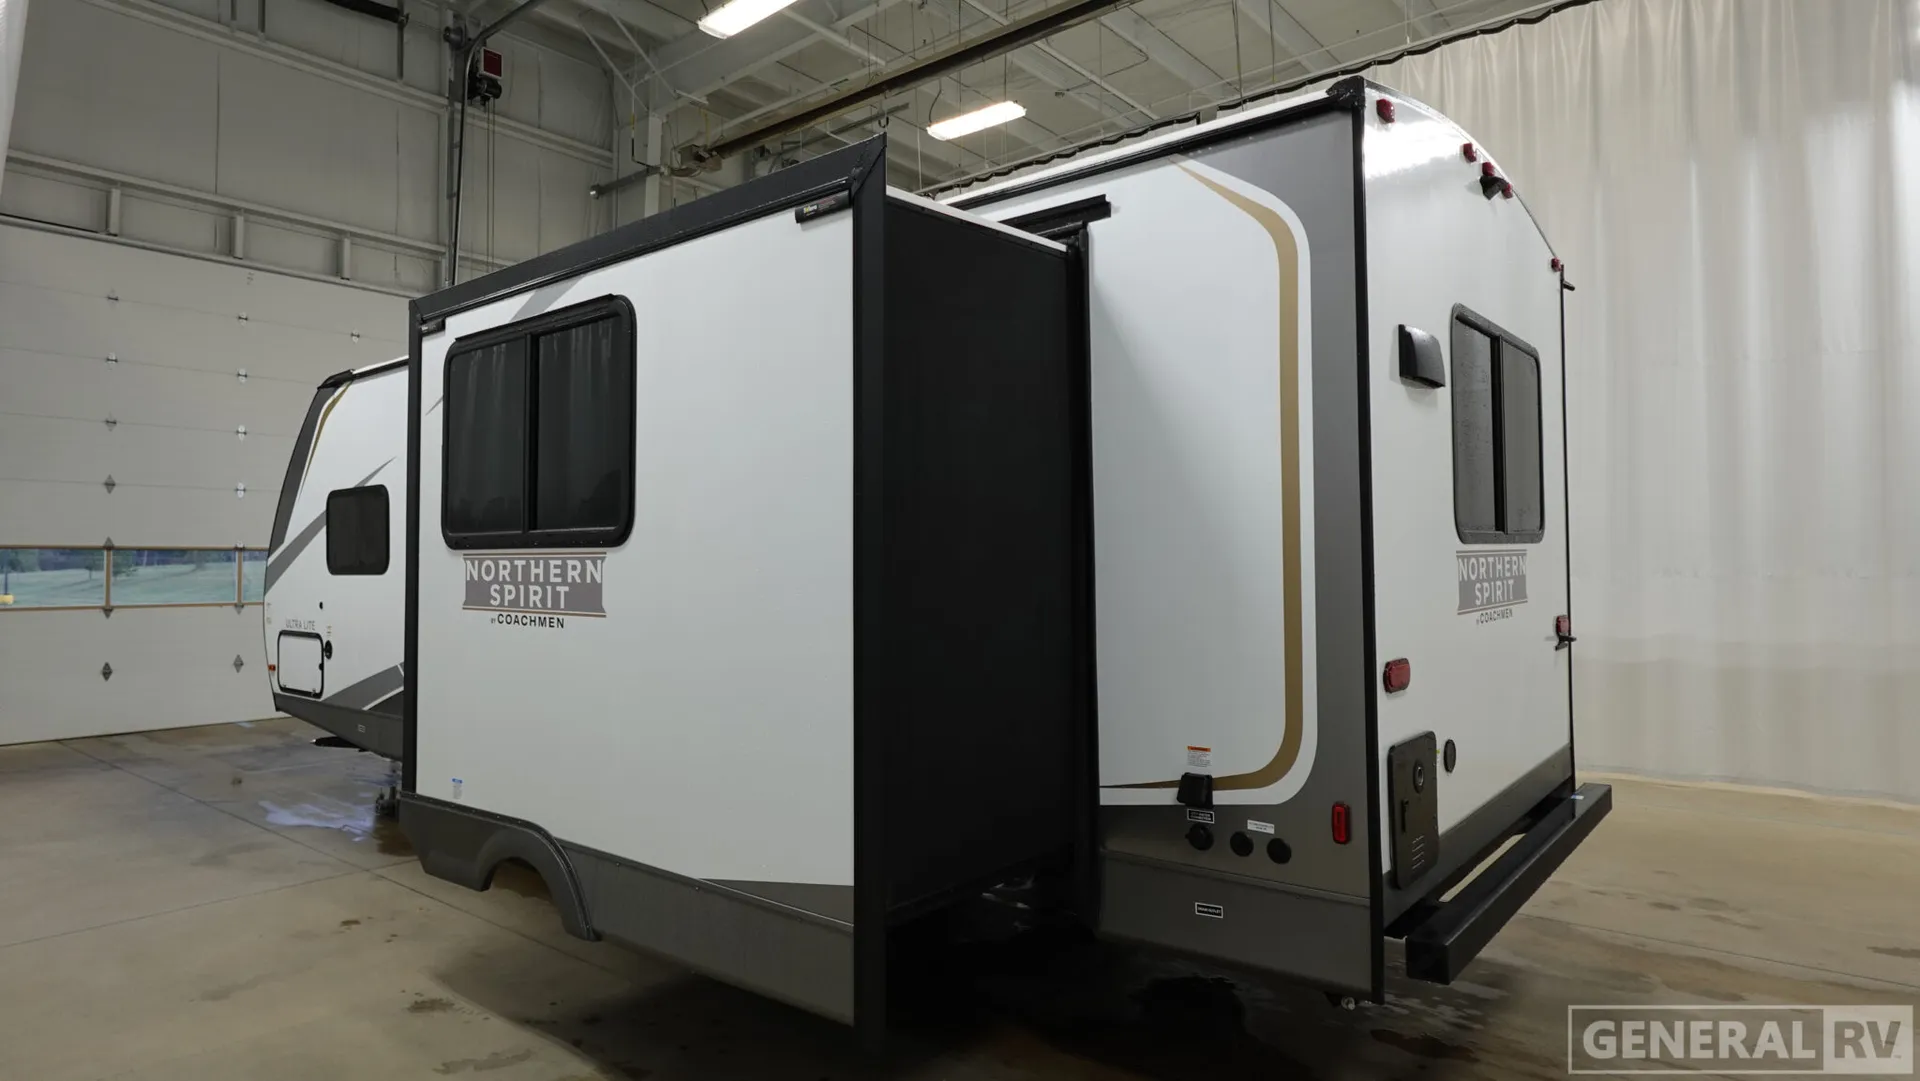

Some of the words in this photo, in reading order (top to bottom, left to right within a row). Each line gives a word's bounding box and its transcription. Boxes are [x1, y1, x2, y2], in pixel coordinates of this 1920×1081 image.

[466, 559, 602, 583] NORTHERN
[1459, 555, 1526, 582] NORTHERN
[490, 584, 570, 609] SPIRIT
[1475, 579, 1515, 605] SPIRIT
[303, 619, 316, 631] LITE
[497, 613, 565, 629] COACHMEN
[1480, 608, 1513, 624] COACHMEN
